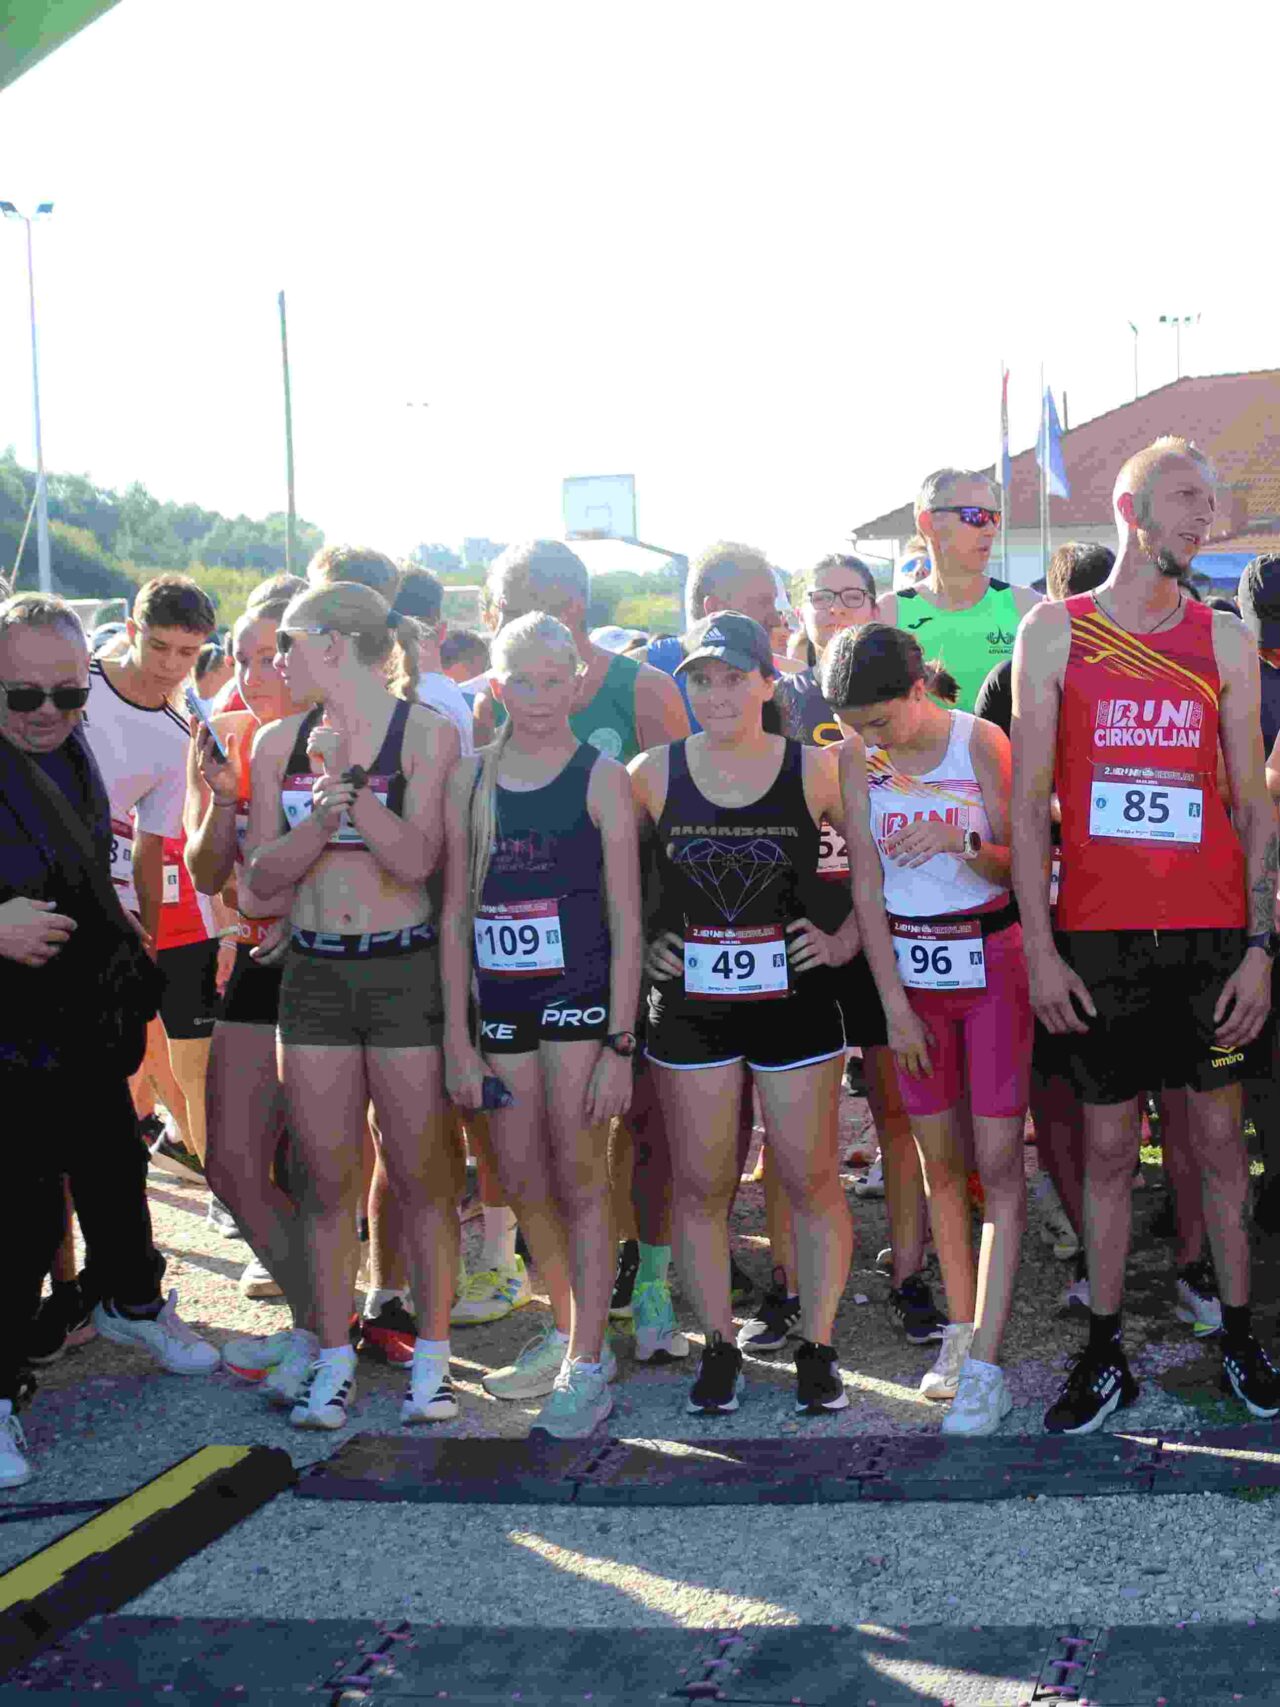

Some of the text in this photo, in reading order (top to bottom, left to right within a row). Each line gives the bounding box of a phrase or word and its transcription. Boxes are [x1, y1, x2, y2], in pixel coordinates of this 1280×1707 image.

[1113, 699, 1189, 728] RUN
[1094, 727, 1200, 748] CIRKOVLJAN
[1123, 790, 1170, 824] 85
[484, 924, 540, 955] 109
[711, 950, 756, 980] 49
[910, 944, 952, 975] 96
[541, 1006, 606, 1027] PRO
[1211, 1052, 1245, 1068] umbro
